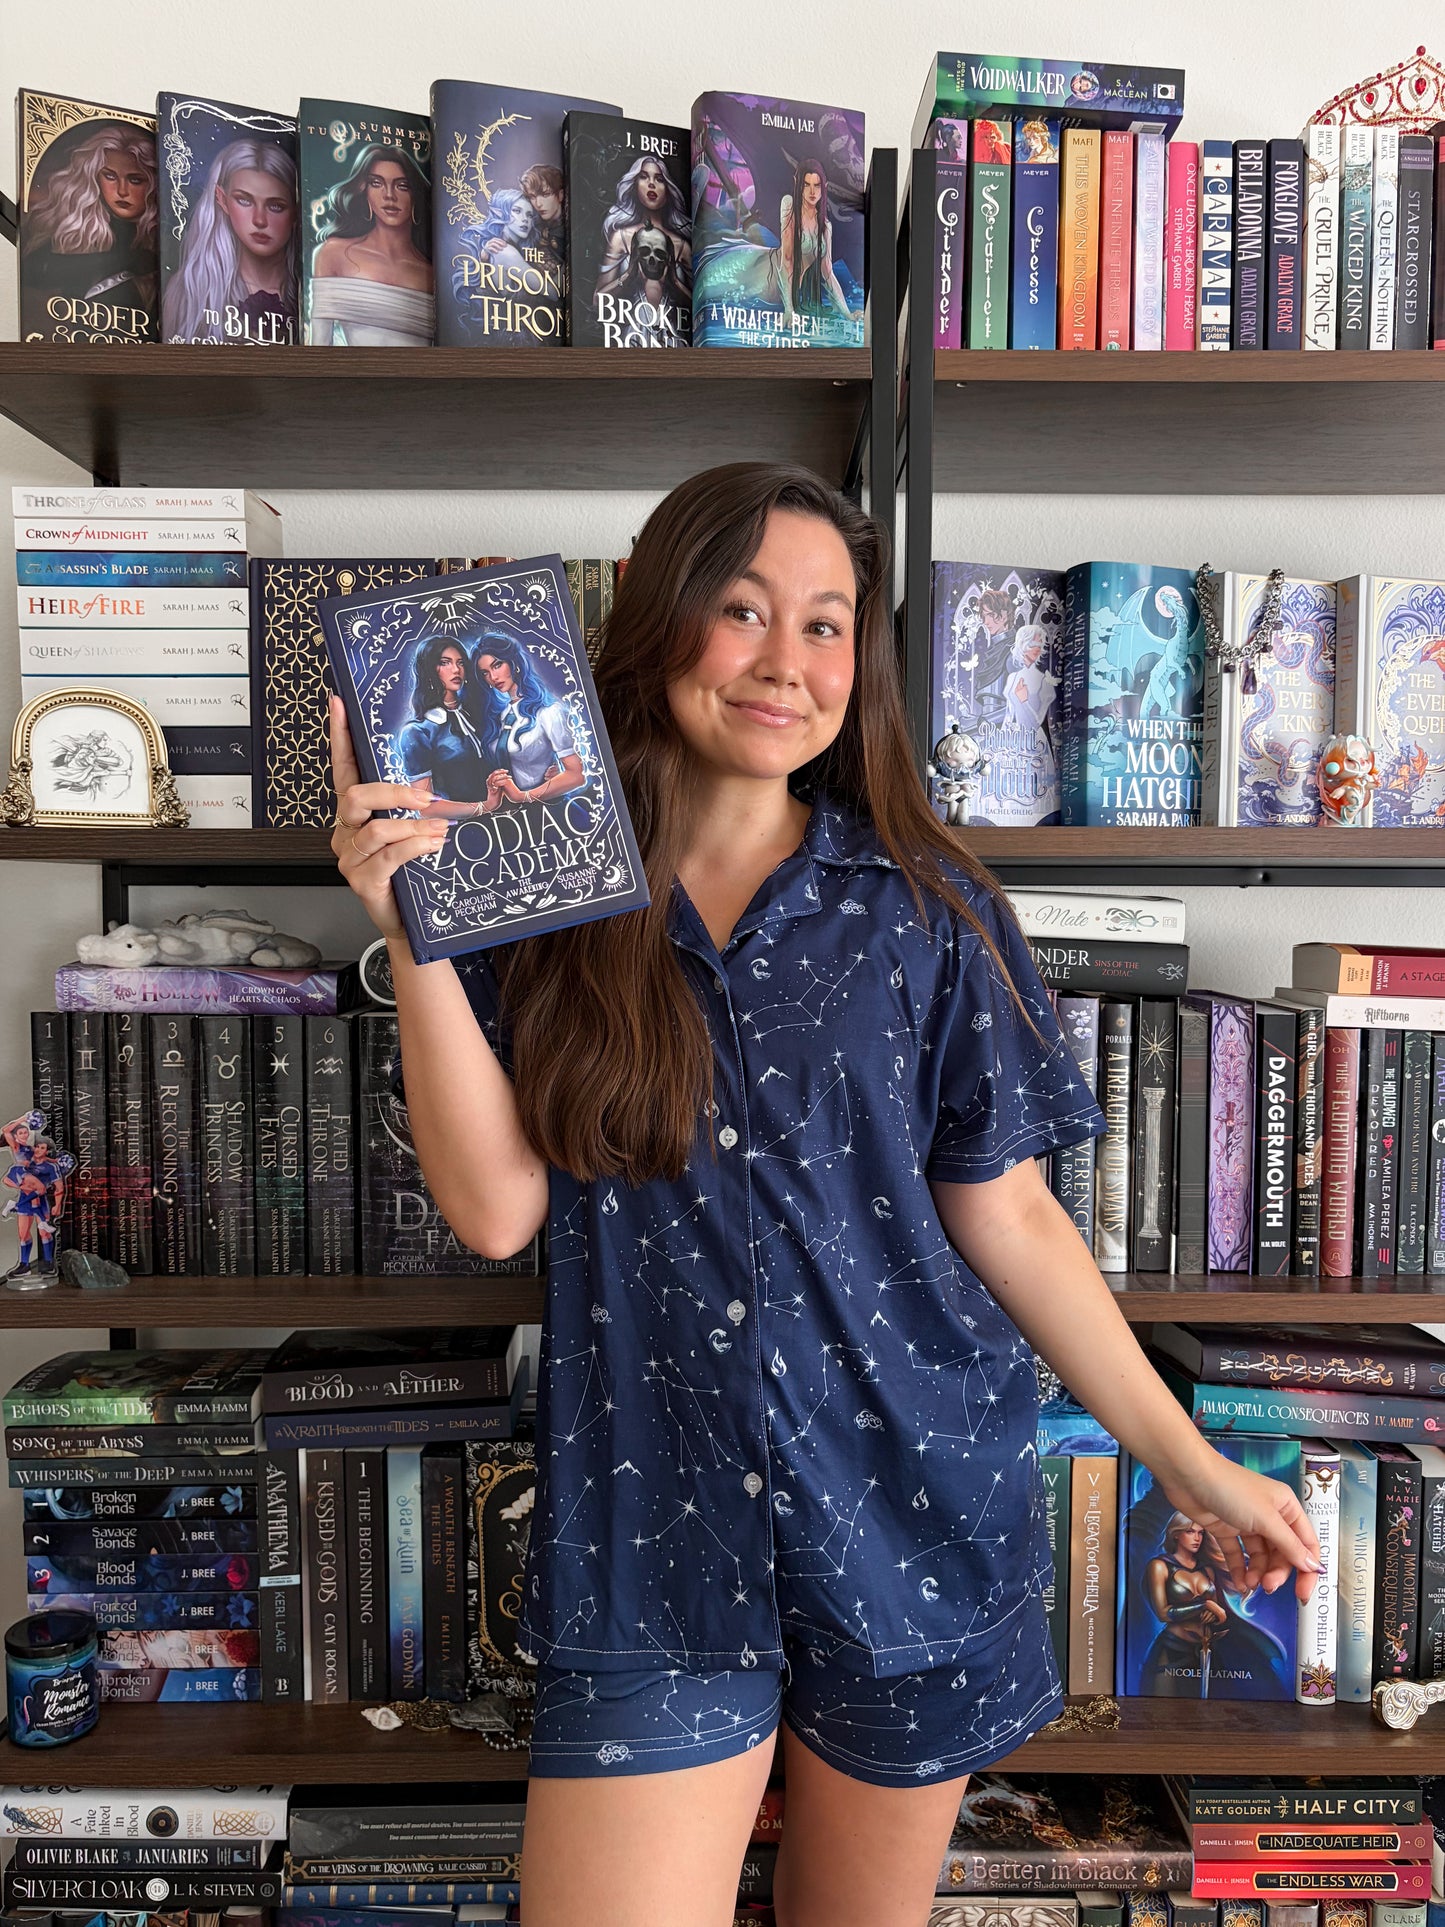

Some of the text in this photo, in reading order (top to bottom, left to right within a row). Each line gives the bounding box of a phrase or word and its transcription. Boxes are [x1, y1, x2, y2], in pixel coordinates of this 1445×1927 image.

[970, 62, 1066, 97] VOIDWALKER
[1104, 88, 1148, 99] MACLEAN
[761, 112, 815, 134] EMILIA JAE
[1072, 138, 1093, 146] MAFI
[1108, 135, 1129, 144] MAFI
[937, 169, 963, 177] MEYER
[979, 169, 1004, 177] MEYER
[1023, 169, 1049, 177] MEYER
[1237, 148, 1263, 262] BELLADONNA
[1274, 160, 1299, 245] FOXGLOVE
[1074, 194, 1088, 250] WOVEN
[1206, 179, 1228, 303] CARAVAL
[522, 247, 546, 264] THE
[937, 187, 959, 335] Cinder
[981, 184, 1000, 339] Scarlet
[1027, 206, 1044, 304] Cress
[1404, 190, 1420, 324] STARCROSSED
[1312, 207, 1335, 335] CRUEL PRINCE
[1345, 208, 1367, 331] WICKED KING
[1376, 210, 1394, 344] QUEEN NOTHING
[1073, 254, 1087, 328] KINGDOM
[47, 296, 150, 336] ORDER
[203, 308, 219, 326] TO
[722, 303, 784, 332] WRAITH
[191, 499, 213, 507] MAAS
[26, 528, 215, 540] CROWN MIDNIGHT SARAH MAAS
[111, 564, 149, 575] BLADE
[154, 566, 180, 574] SARAH
[29, 597, 145, 615] HEIR FIRE
[29, 646, 73, 659] QUEEN
[1274, 671, 1301, 686] THE
[1408, 673, 1436, 689] THE
[1127, 719, 1174, 740] WHEN
[1277, 714, 1331, 733] KING
[1116, 812, 1157, 827] SARAH
[450, 836, 593, 894] ACADEMY
[557, 867, 597, 884] SUSANNE
[506, 881, 549, 898] AWAKENING
[452, 892, 496, 910] CAROLINE
[455, 901, 498, 918] PECKHAM
[1035, 905, 1089, 927] Mate
[1095, 960, 1111, 968] SINS
[1101, 969, 1133, 977] ZODIAC
[141, 983, 222, 1003] HOLLOW
[229, 994, 301, 1004] HEARTS CHAOS
[242, 986, 288, 995] CROWN OF
[1364, 1007, 1410, 1024] Riftborne
[275, 1026, 284, 1043] 5
[1305, 1033, 1317, 1149] GIRL THOUSAND
[1106, 1065, 1129, 1153] TREACHERY
[1382, 1081, 1397, 1127] HOLLOWED
[77, 1090, 92, 1180] AWAKENING
[126, 1100, 141, 1166] RUTHLESS
[160, 1085, 180, 1193] RECKONING
[1328, 1090, 1351, 1174] FLOATING
[205, 1104, 224, 1183] PRINCESS
[226, 1101, 245, 1183] SHADOW
[260, 1116, 280, 1169] FATES
[281, 1106, 301, 1179] CURSED
[311, 1104, 330, 1183] THRONE
[331, 1115, 350, 1172] FATED
[1266, 1057, 1286, 1227] DAGGERMOUTH
[1104, 1181, 1127, 1233] SWANS
[1381, 1158, 1391, 1238] AMILEA PEREZ
[384, 1261, 435, 1273] PECKHAM
[470, 1261, 521, 1273] VALENTI
[1219, 1356, 1382, 1381] WEAVINGSHAW
[12, 1403, 248, 1419] ECHOES EMMA HAMM
[1202, 1399, 1414, 1428] IMMORTAL CONSEQUENCES MARIE
[449, 1420, 479, 1429] EMILIA
[12, 1435, 249, 1452] SONG ABYSS EMMA HAMM
[16, 1467, 253, 1485] WHISPERS DEEP EMMA HAMM
[191, 1498, 215, 1507] BREE
[1386, 1494, 1420, 1503] MARIE
[267, 1461, 289, 1571] ANATHEMA
[191, 1532, 215, 1540] BREE
[1354, 1532, 1368, 1574] WINGS
[97, 1561, 135, 1573] Blood
[358, 1527, 373, 1624] BEGINNING
[191, 1607, 214, 1616] BREE
[274, 1591, 286, 1617] KERI
[402, 1628, 414, 1688] GODWIN
[323, 1649, 337, 1694] ROGAN
[1164, 1668, 1202, 1678] NICOLE
[1196, 1806, 1271, 1815] KATE GOLDEN
[1294, 1799, 1400, 1815] HALF CITY
[127, 1805, 140, 1837] Blood
[1270, 1836, 1361, 1850] INADEQUATE
[1363, 1836, 1395, 1847] HEIR
[26, 1848, 71, 1865] OLIVIE
[75, 1848, 118, 1864] BLAKE
[136, 1848, 208, 1864] JANUARIES
[330, 1862, 488, 1874] VEINS DROWNING CASSIDY
[972, 1856, 1138, 1881] Better in Black
[12, 1877, 255, 1899] SILVERCLOAK STEVEN
[972, 1880, 988, 1888] Ten
[990, 1881, 1019, 1889] Stories
[1033, 1880, 1096, 1889] Shadowhunter
[1280, 1875, 1345, 1887] ENDLESS
[1348, 1875, 1384, 1887] WAR
[1385, 1913, 1421, 1924] CLARE
